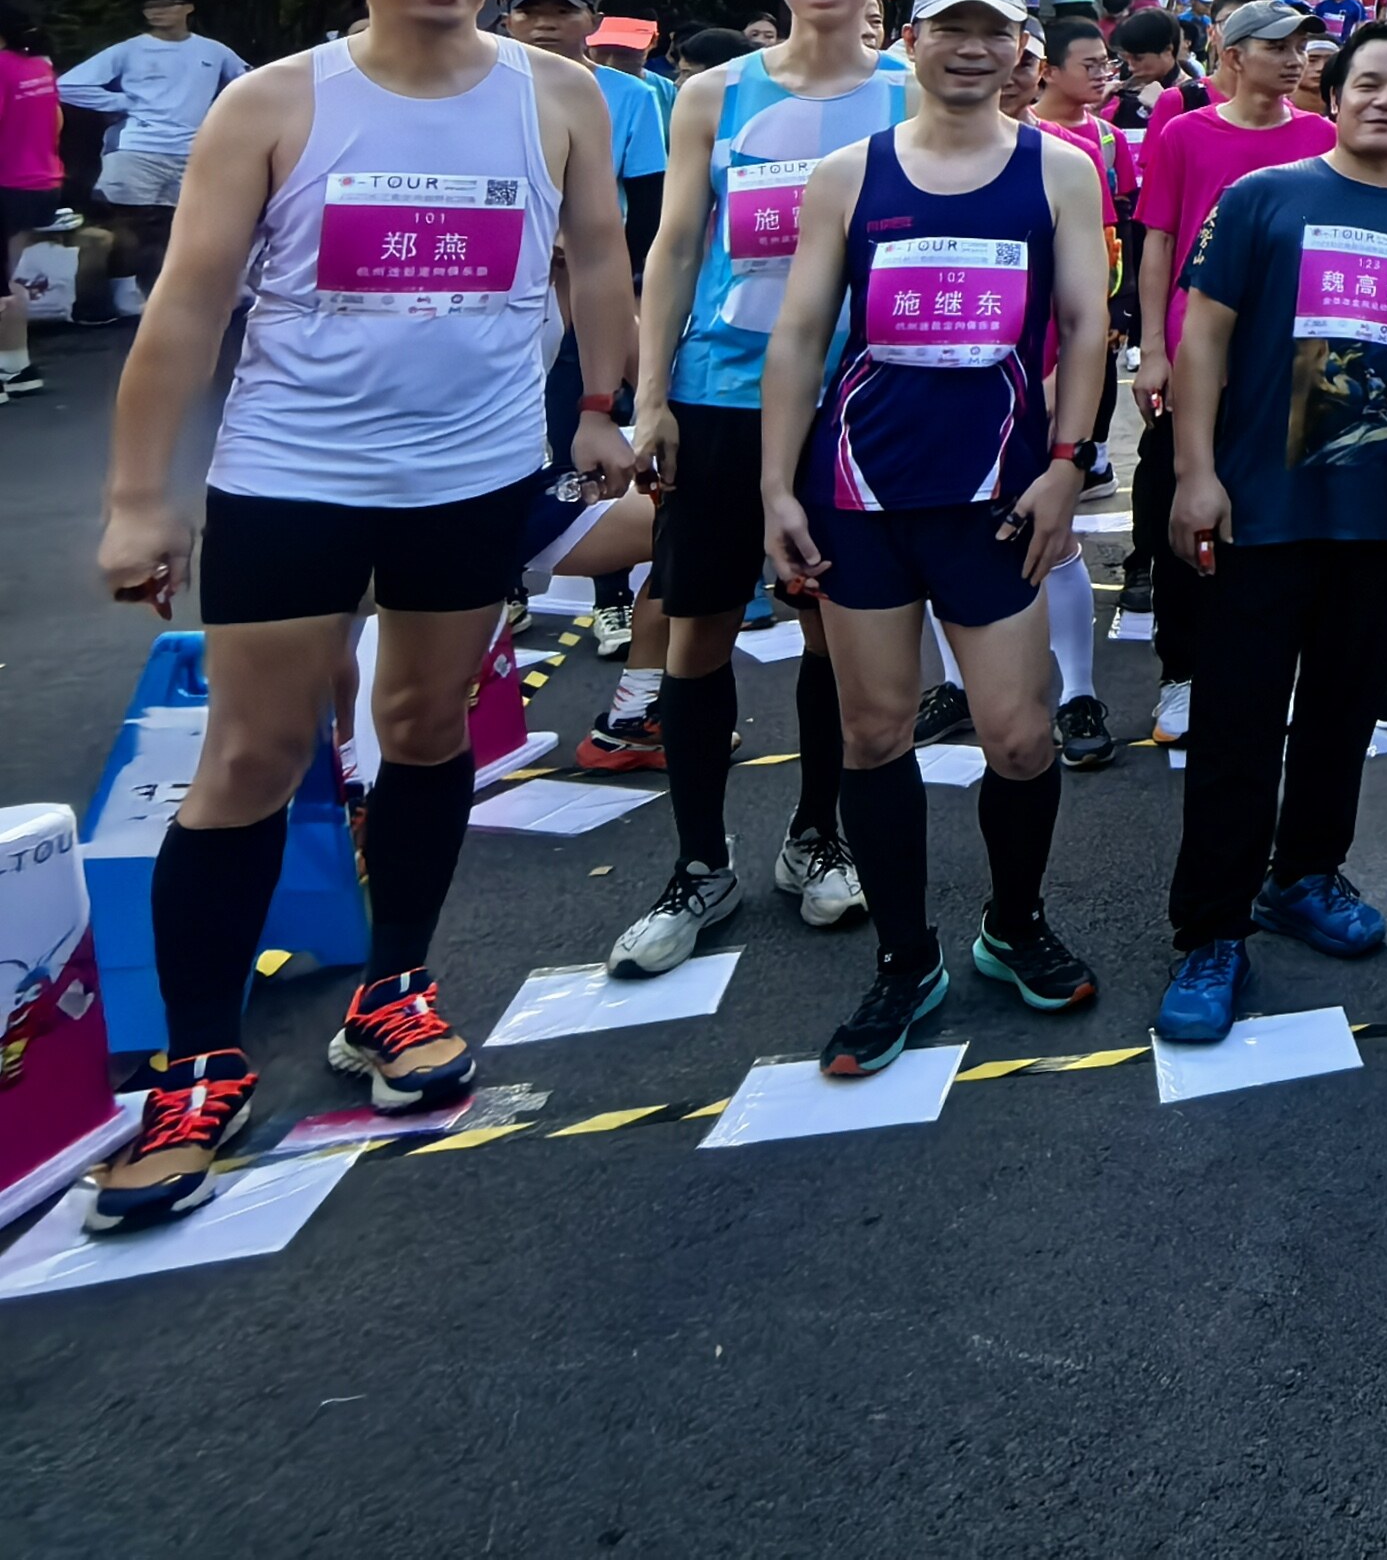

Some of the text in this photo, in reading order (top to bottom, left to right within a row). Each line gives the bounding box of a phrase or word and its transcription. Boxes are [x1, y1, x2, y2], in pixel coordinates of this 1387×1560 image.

[414, 212, 446, 224] 101
[380, 231, 469, 261] 郑燕
[938, 271, 966, 283] 102
[892, 289, 1002, 316] 施继东
